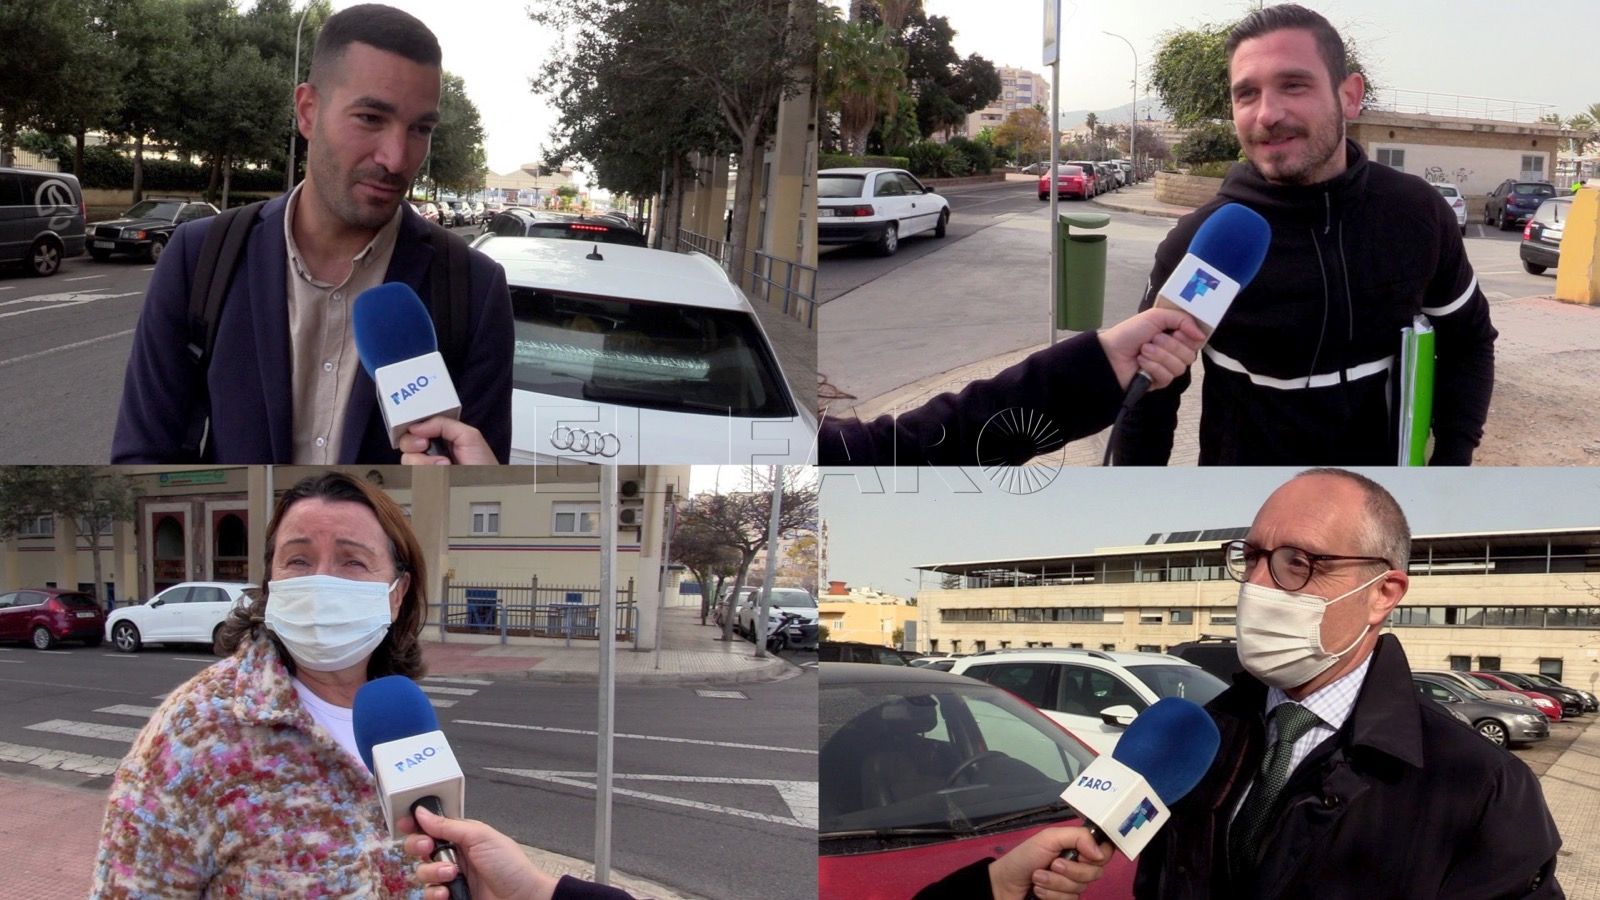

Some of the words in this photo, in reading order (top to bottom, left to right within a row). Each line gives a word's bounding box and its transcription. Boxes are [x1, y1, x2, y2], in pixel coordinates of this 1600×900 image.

[390, 375, 429, 405] FARO
[394, 746, 436, 772] FARO
[1077, 776, 1112, 791] FARO
